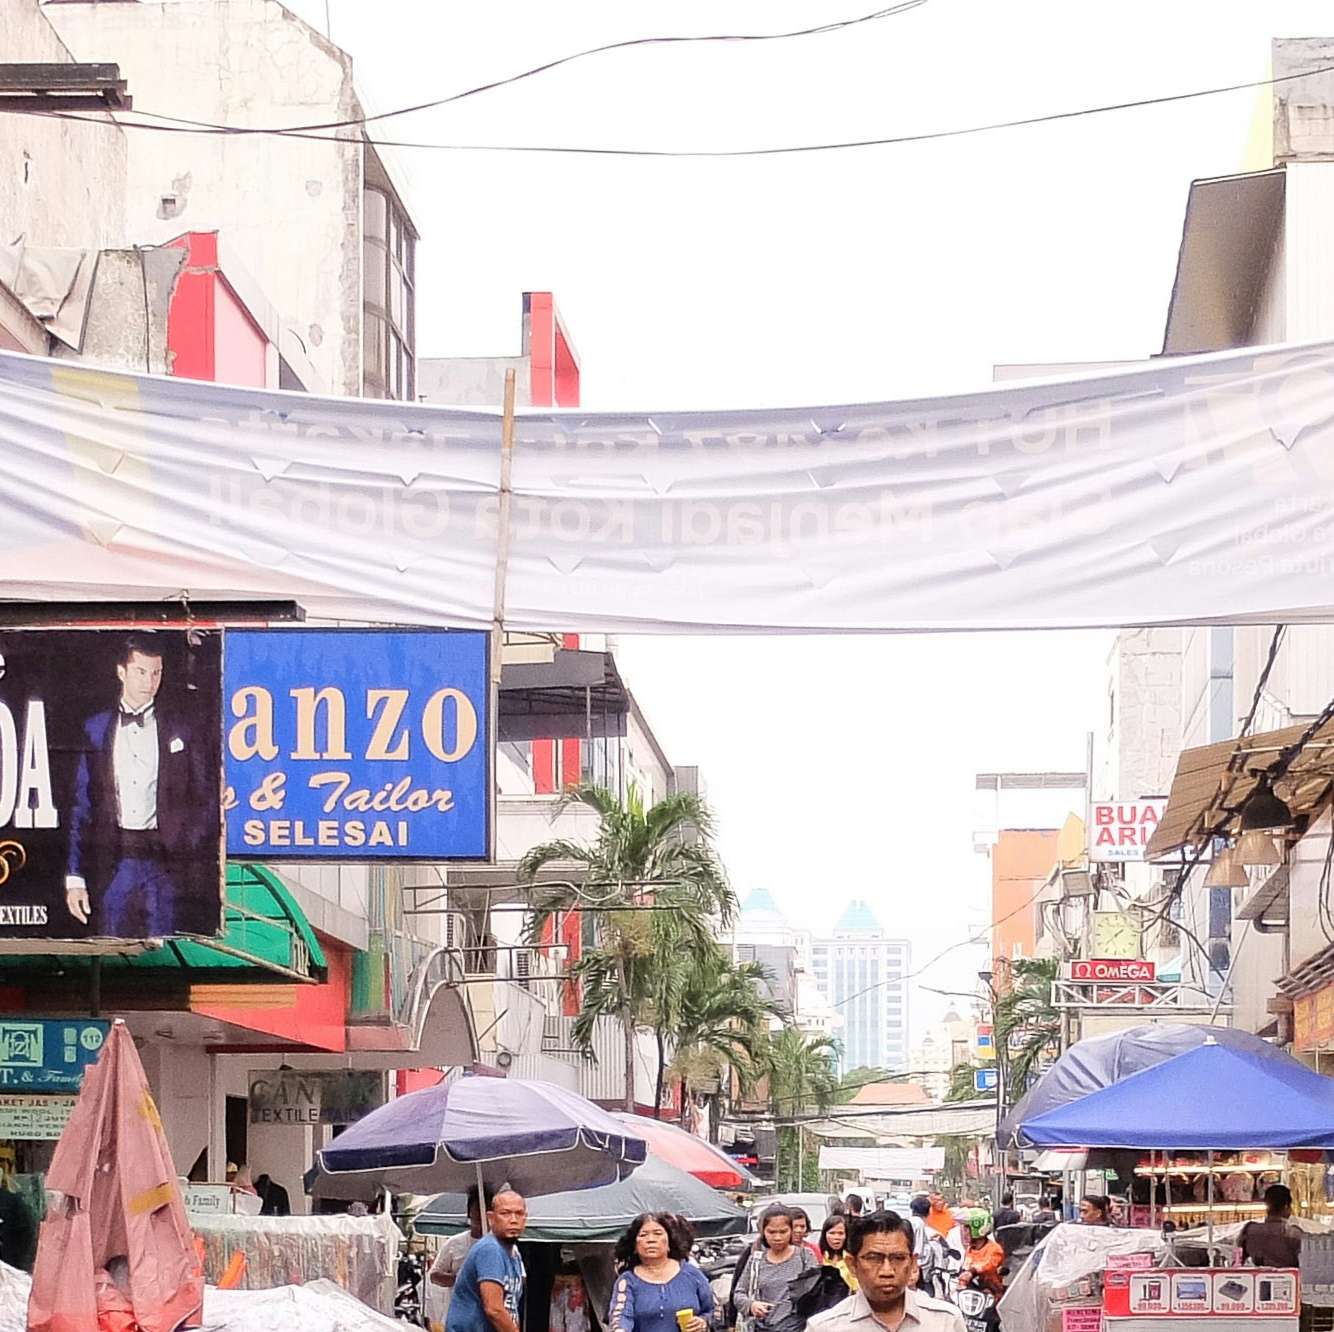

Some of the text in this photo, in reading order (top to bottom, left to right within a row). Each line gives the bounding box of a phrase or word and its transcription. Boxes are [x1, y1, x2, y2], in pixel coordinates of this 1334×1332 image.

[249, 772, 287, 812] &
[308, 771, 455, 813] Tailor
[1096, 806, 1165, 825] BUA
[243, 820, 408, 847] SELESAI
[1095, 964, 1151, 979] OMEGA
